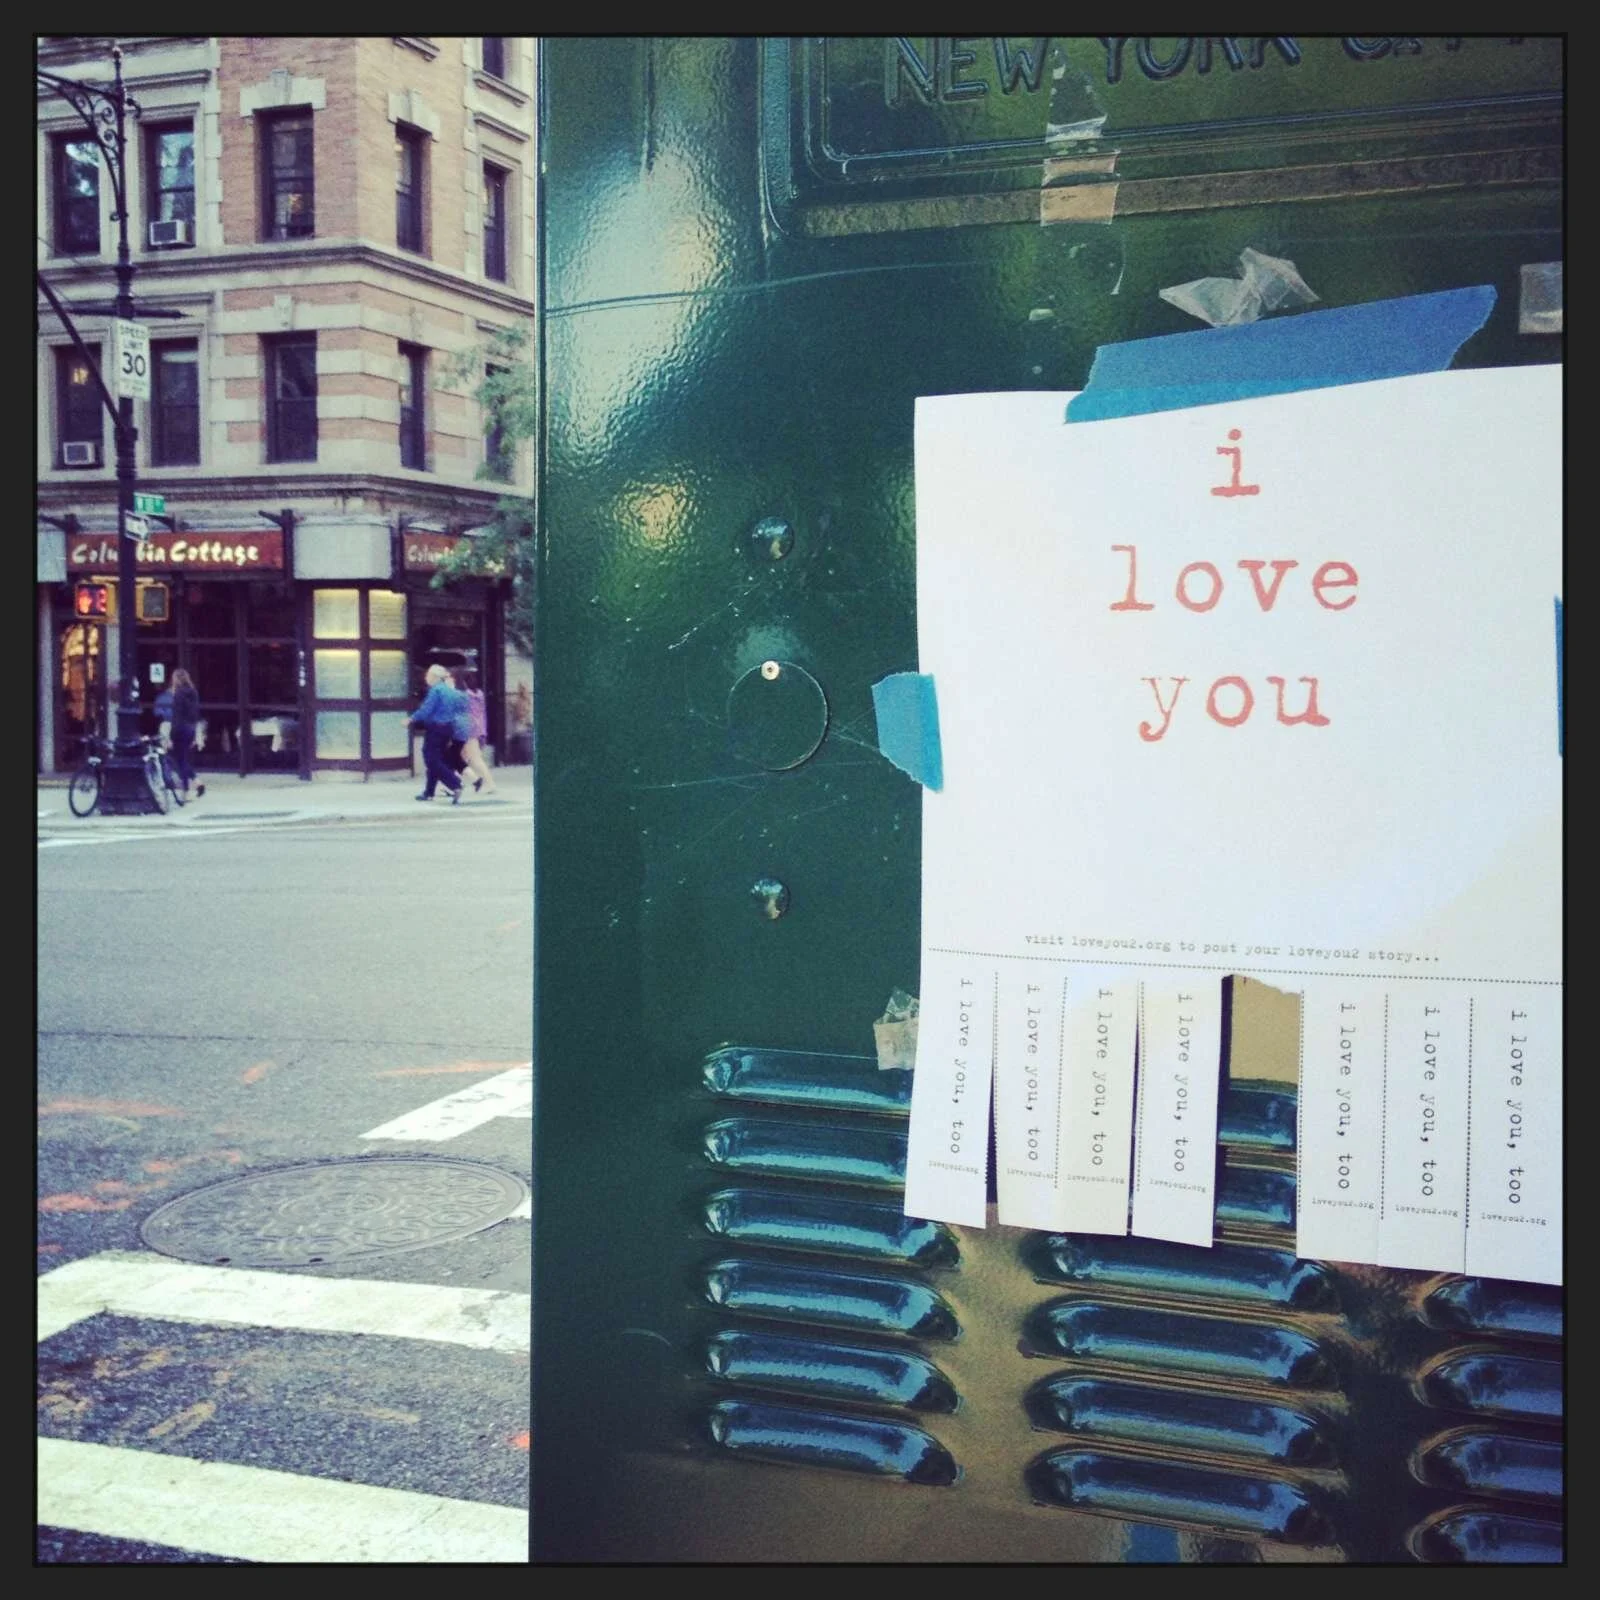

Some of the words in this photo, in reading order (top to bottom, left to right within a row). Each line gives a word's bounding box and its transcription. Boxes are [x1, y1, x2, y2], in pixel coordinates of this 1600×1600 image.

[884, 38, 1051, 107] NEW
[122, 351, 147, 377] 30
[1211, 428, 1261, 498] i
[71, 541, 166, 564] Colubia
[169, 540, 259, 567] Cottage
[1110, 544, 1360, 614] love
[1139, 675, 1330, 743] you
[1025, 935, 1064, 946] visit
[1071, 936, 1171, 953] loveyou2.org
[1179, 940, 1196, 952] to
[1203, 942, 1236, 955] post
[1244, 945, 1281, 957] your
[1288, 945, 1360, 960] loveyou2
[1368, 949, 1439, 964] story...
[960, 978, 974, 988] i
[1026, 983, 1041, 994] i
[1098, 988, 1113, 1000] i
[1177, 993, 1193, 1004] i
[958, 1001, 973, 1047] love
[1027, 1007, 1041, 1054] love
[1340, 1002, 1357, 1014] i
[1424, 1005, 1441, 1017] i
[1511, 1009, 1528, 1022] i
[1095, 1011, 1113, 1059] love
[1178, 1015, 1194, 1063] love
[1339, 1025, 1357, 1076] love
[1423, 1030, 1441, 1081] love
[951, 1058, 967, 1104] you,
[1509, 1034, 1528, 1087] love
[1024, 1065, 1038, 1112] you,
[1090, 1070, 1107, 1117] you,
[1173, 1073, 1188, 1121] you,
[1335, 1088, 1352, 1137] you,
[1419, 1093, 1436, 1143] you,
[1506, 1099, 1523, 1150] you,
[949, 1119, 965, 1154] too
[1027, 1127, 1041, 1161] too
[1091, 1131, 1108, 1166] too
[1173, 1136, 1189, 1172] too
[1337, 1152, 1353, 1190] too
[1420, 1159, 1438, 1197] too
[1507, 1165, 1526, 1205] too
